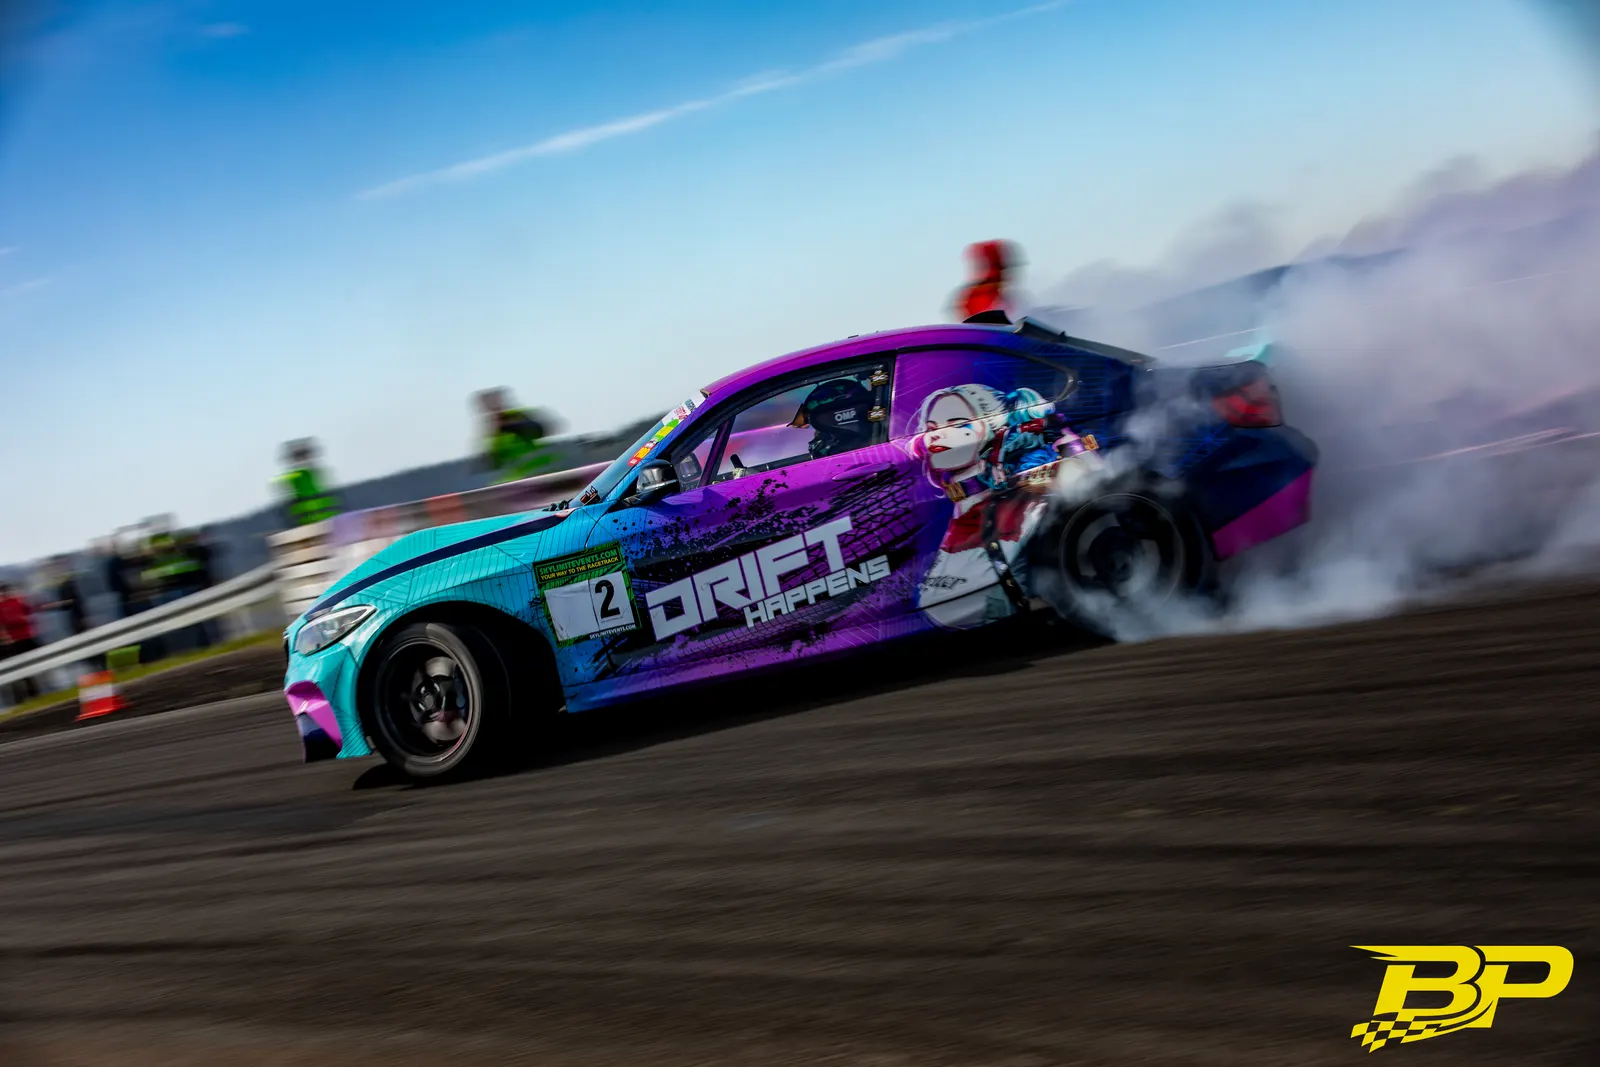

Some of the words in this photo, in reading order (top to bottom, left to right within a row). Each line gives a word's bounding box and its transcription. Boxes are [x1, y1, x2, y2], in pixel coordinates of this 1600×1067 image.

[834, 410, 857, 422] OMP
[539, 549, 617, 575] SKYLIMITEVENTS.COM
[587, 557, 618, 569] RACETRACK
[645, 516, 853, 641] DRIFT
[743, 555, 892, 627] HAPPENS
[595, 580, 620, 619] 2
